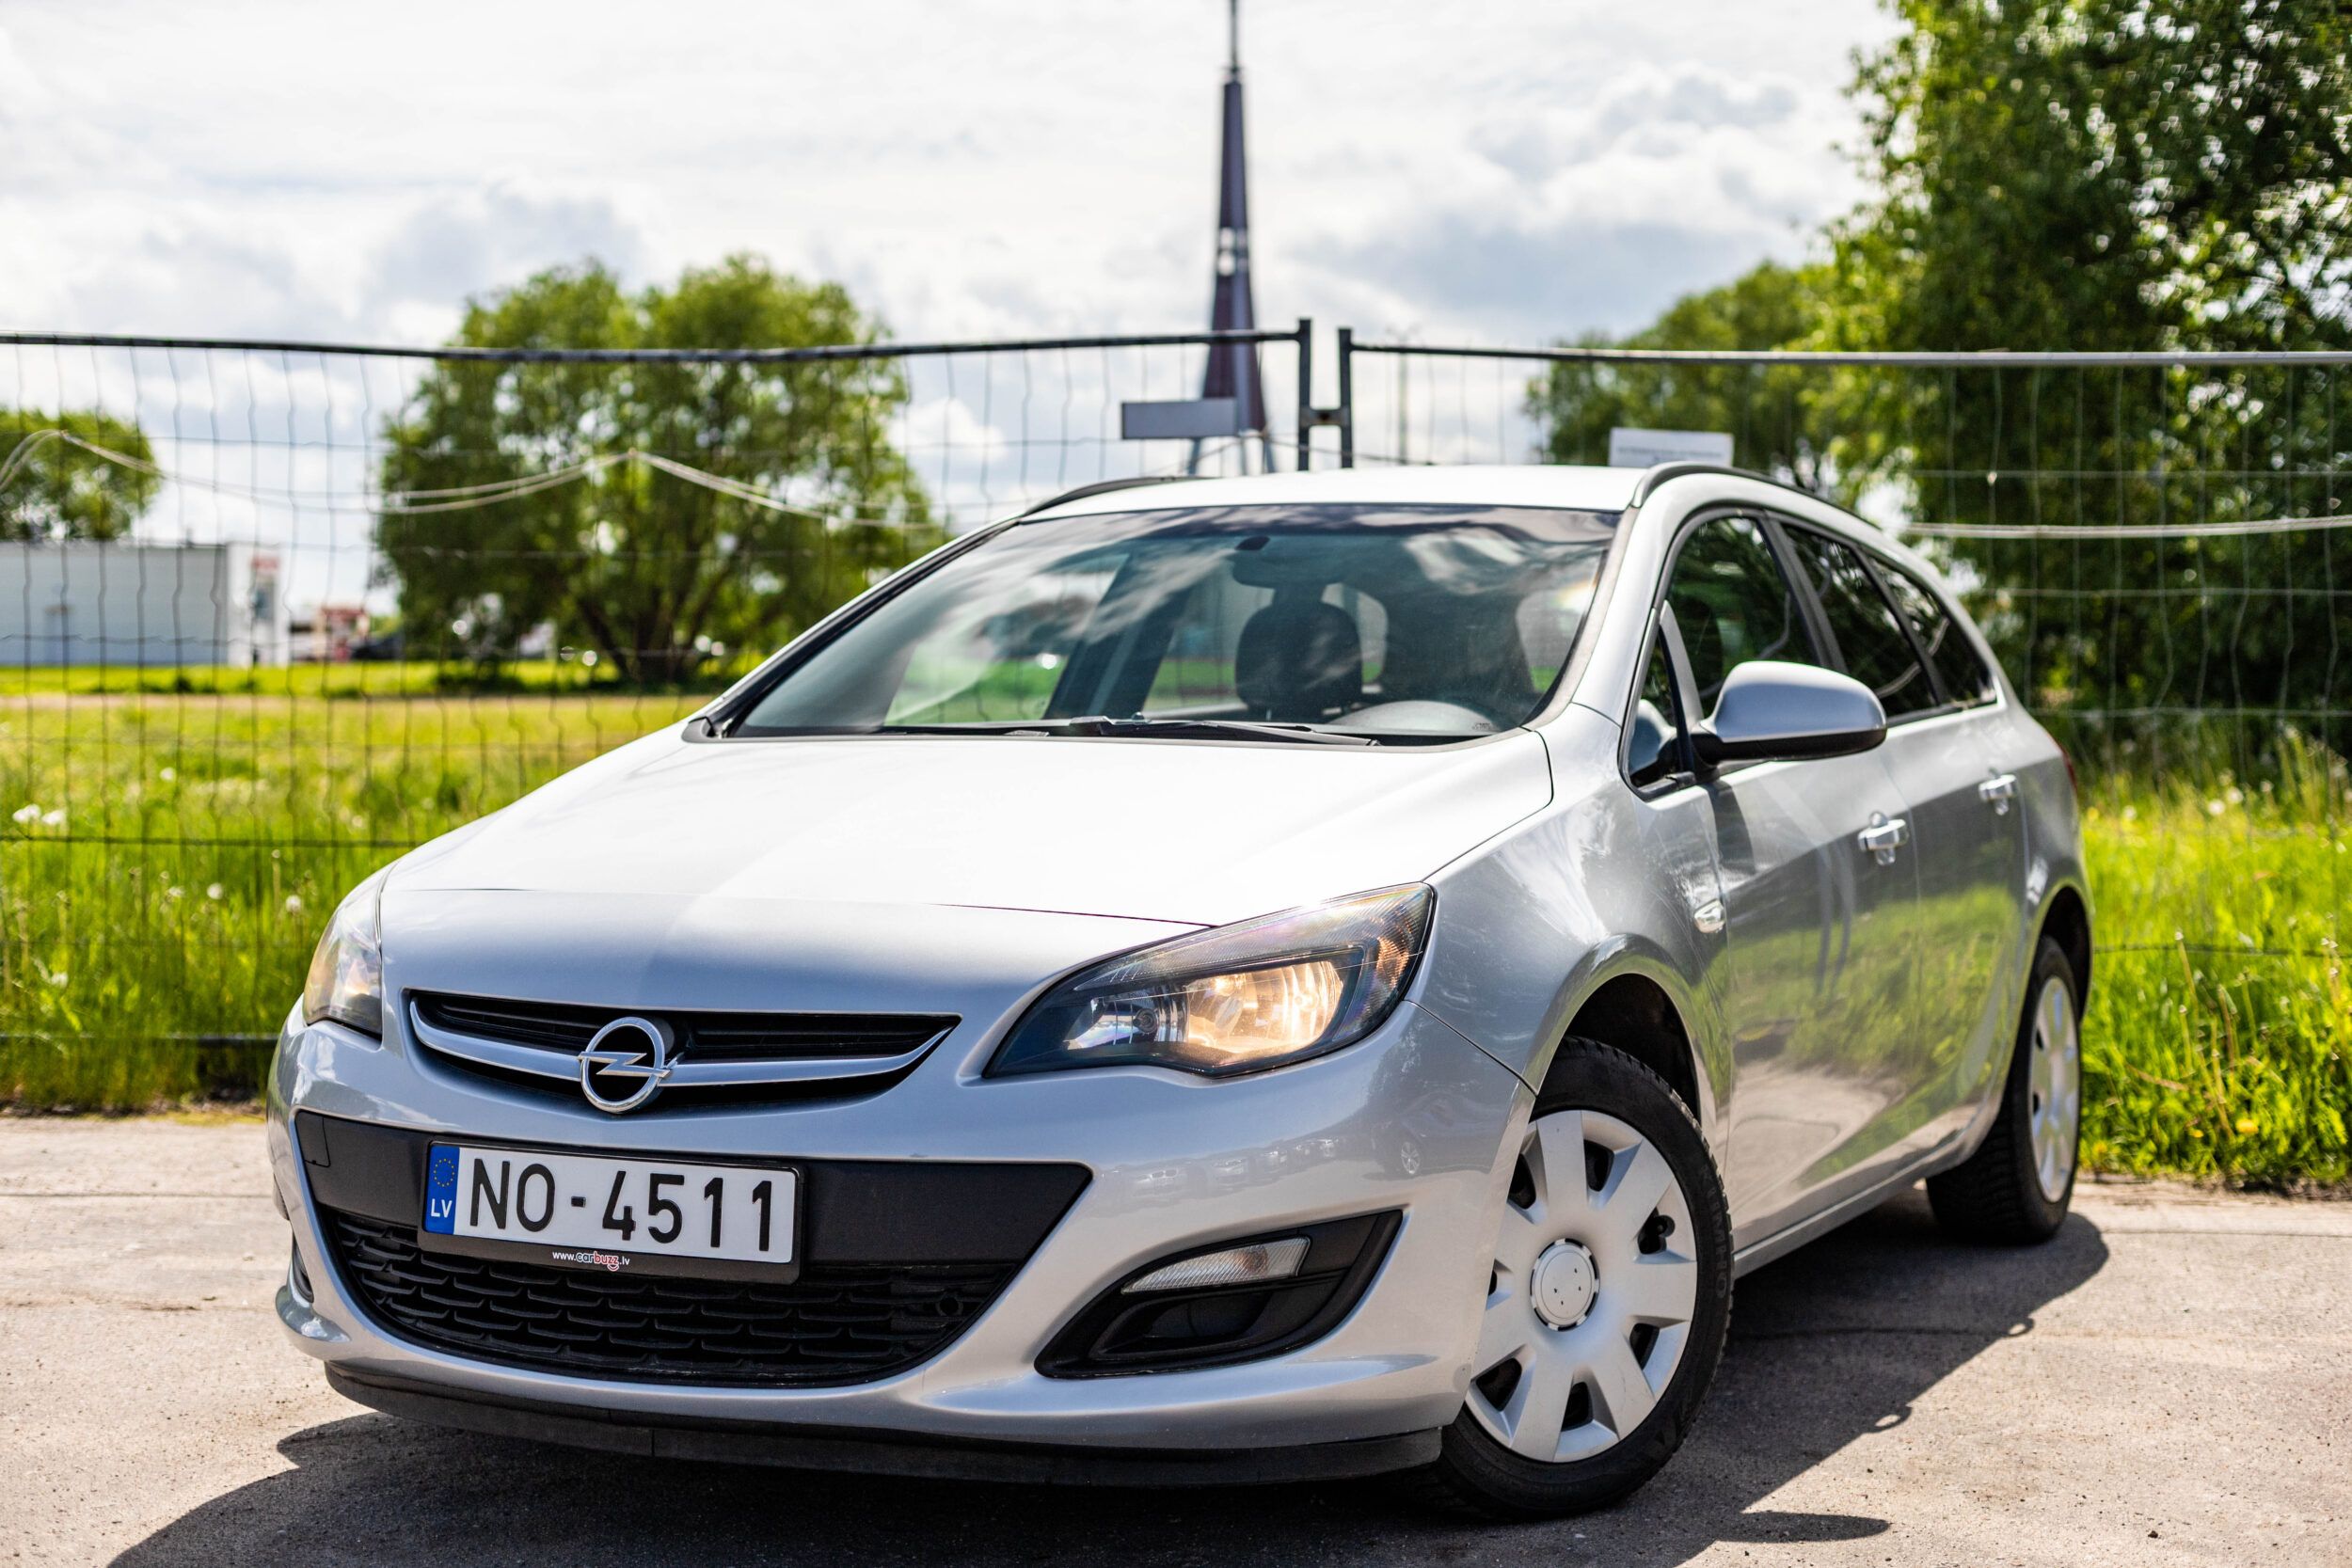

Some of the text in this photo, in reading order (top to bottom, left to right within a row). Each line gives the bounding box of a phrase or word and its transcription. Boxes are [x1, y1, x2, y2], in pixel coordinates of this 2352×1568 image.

[430, 1198, 453, 1219] LV
[469, 1158, 772, 1252] NO-4511
[552, 1250, 630, 1267] www.carbuzz.lv
